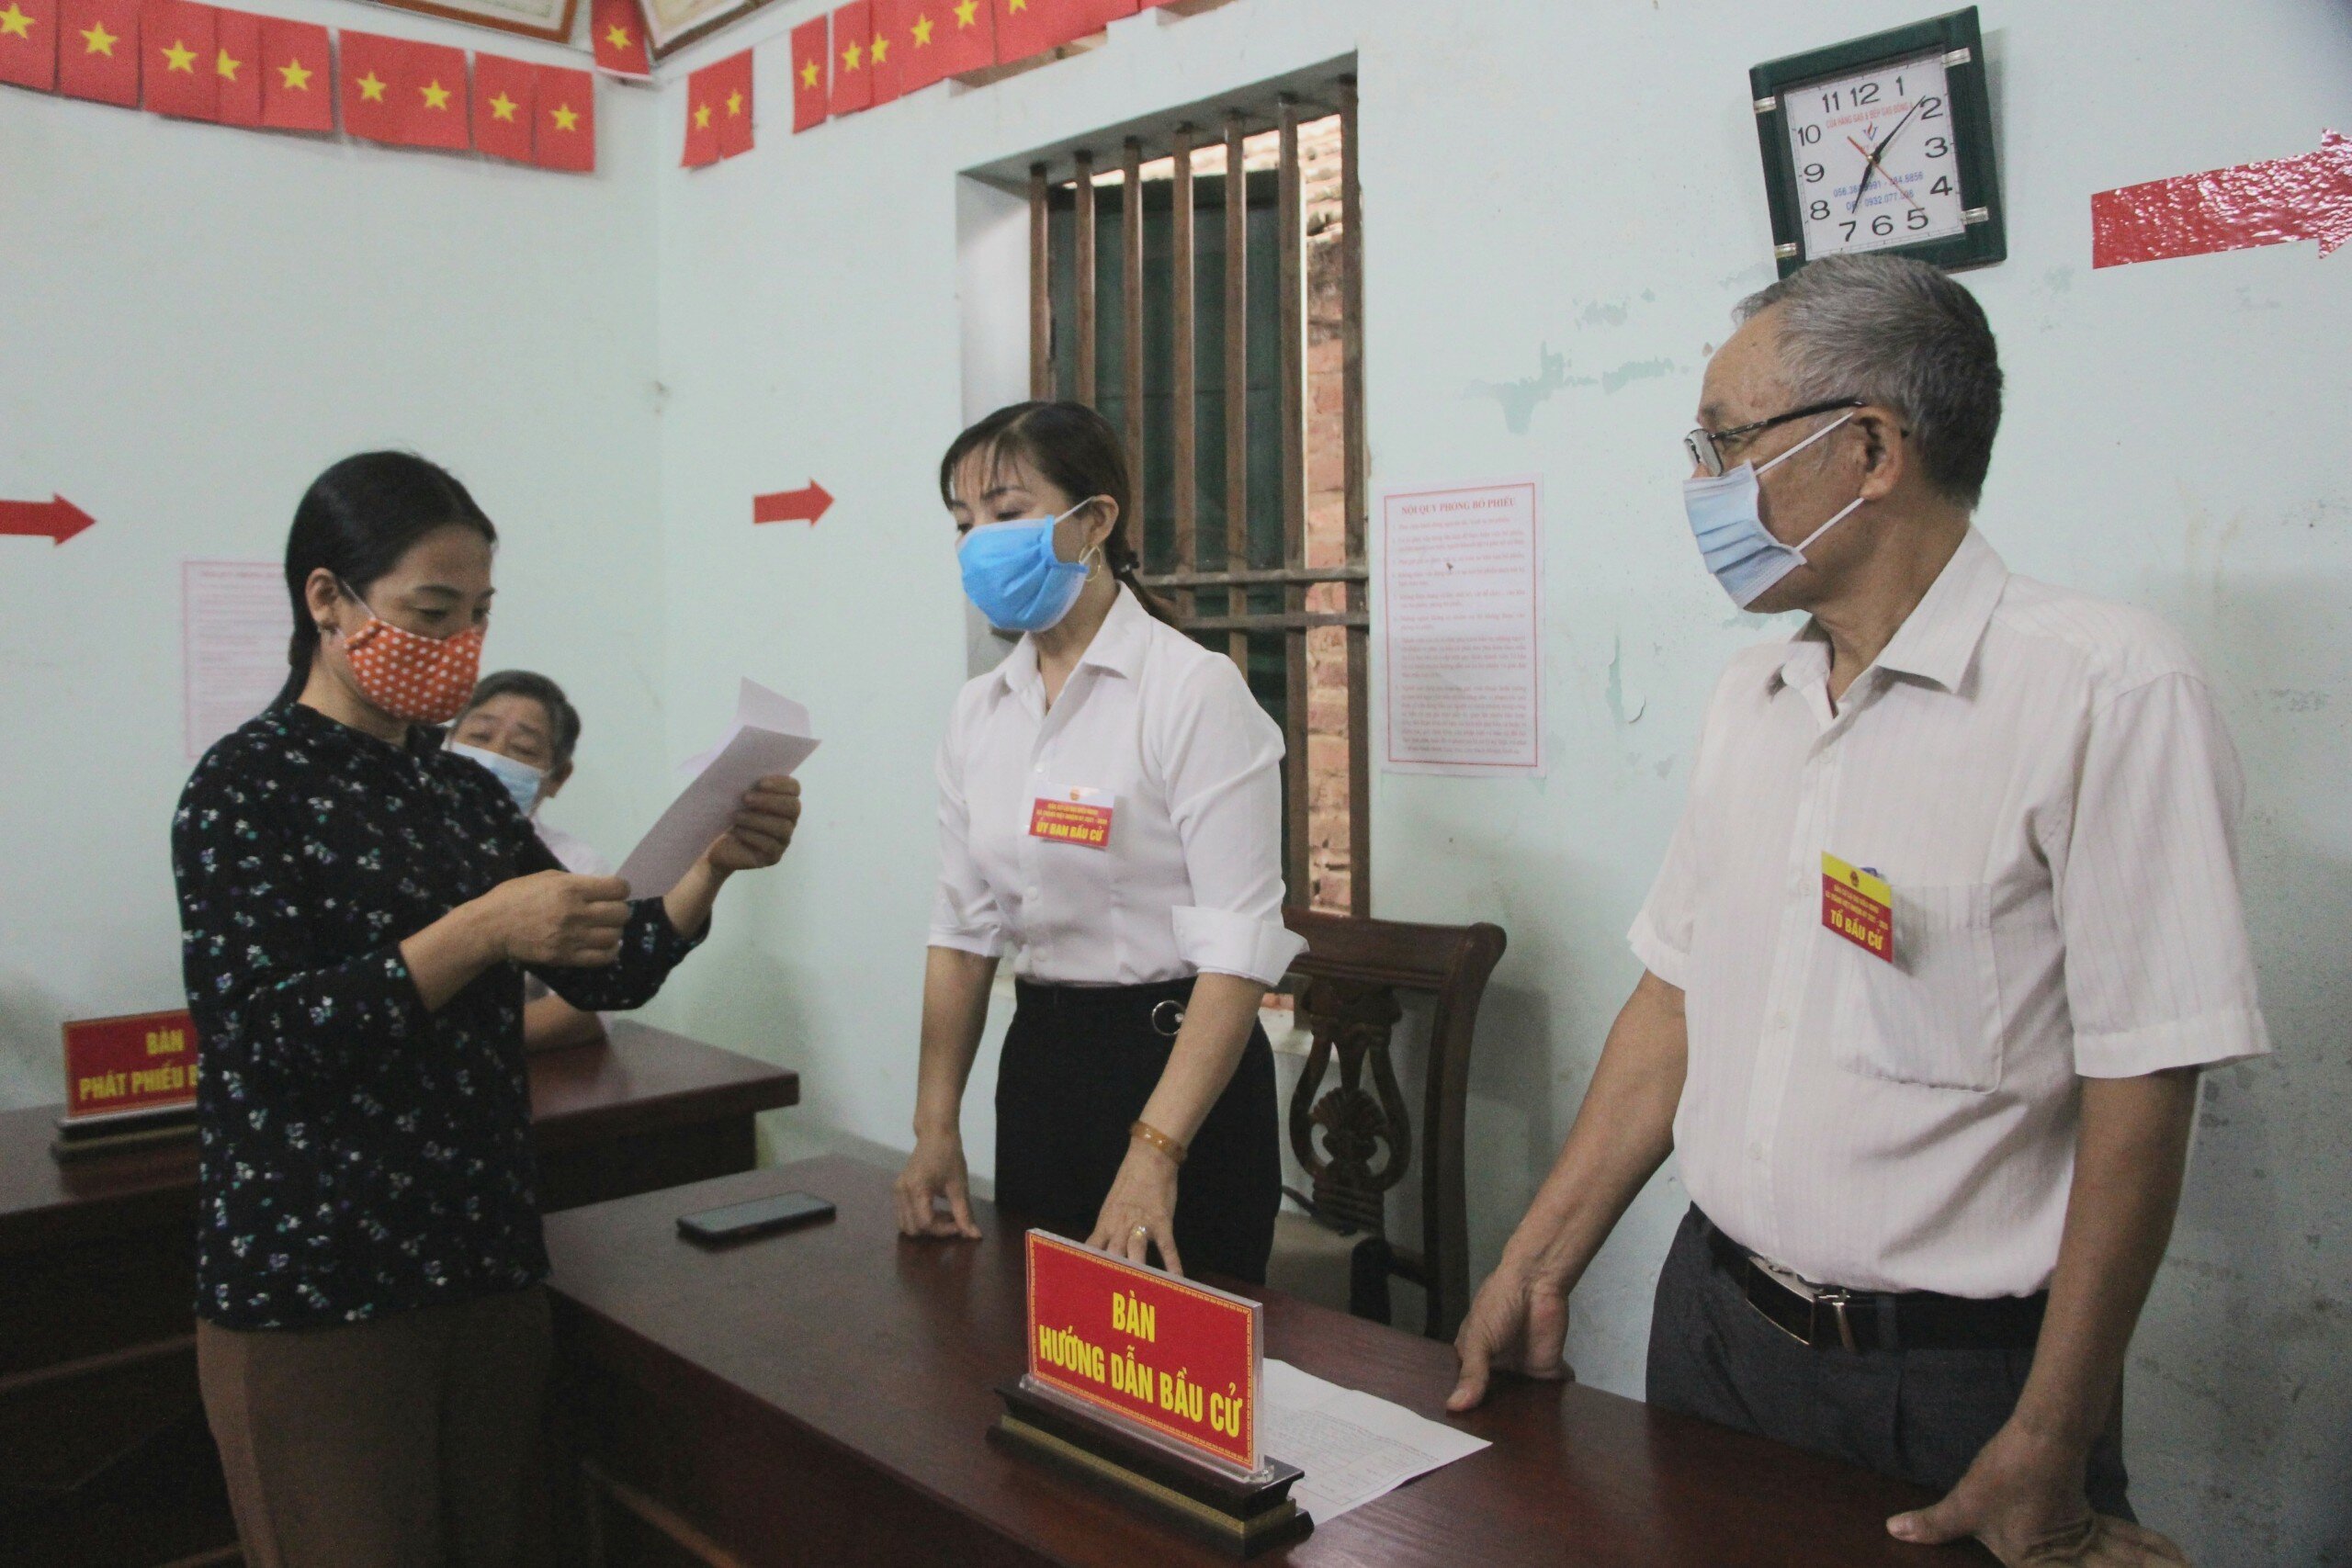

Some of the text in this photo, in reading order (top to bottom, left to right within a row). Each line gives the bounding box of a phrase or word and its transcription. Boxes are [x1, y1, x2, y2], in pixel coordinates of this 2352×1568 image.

[1850, 83, 1881, 107] 12
[1896, 76, 1905, 96] 1
[1823, 91, 1840, 113] 11
[1920, 96, 1943, 120] 2
[1798, 125, 1822, 146] 10
[1925, 137, 1948, 158] 3
[1804, 164, 1825, 183] 9
[1929, 175, 1953, 197] 4
[1810, 199, 1830, 220] 8
[1907, 208, 1928, 230] 5
[1838, 220, 1857, 242] 7
[1871, 215, 1894, 235] 6
[79, 1068, 127, 1101] PHÁT
[1112, 1290, 1156, 1343] BÀN
[1039, 1325, 1243, 1438] HƯỚNG DẪN BẦU CỬ
